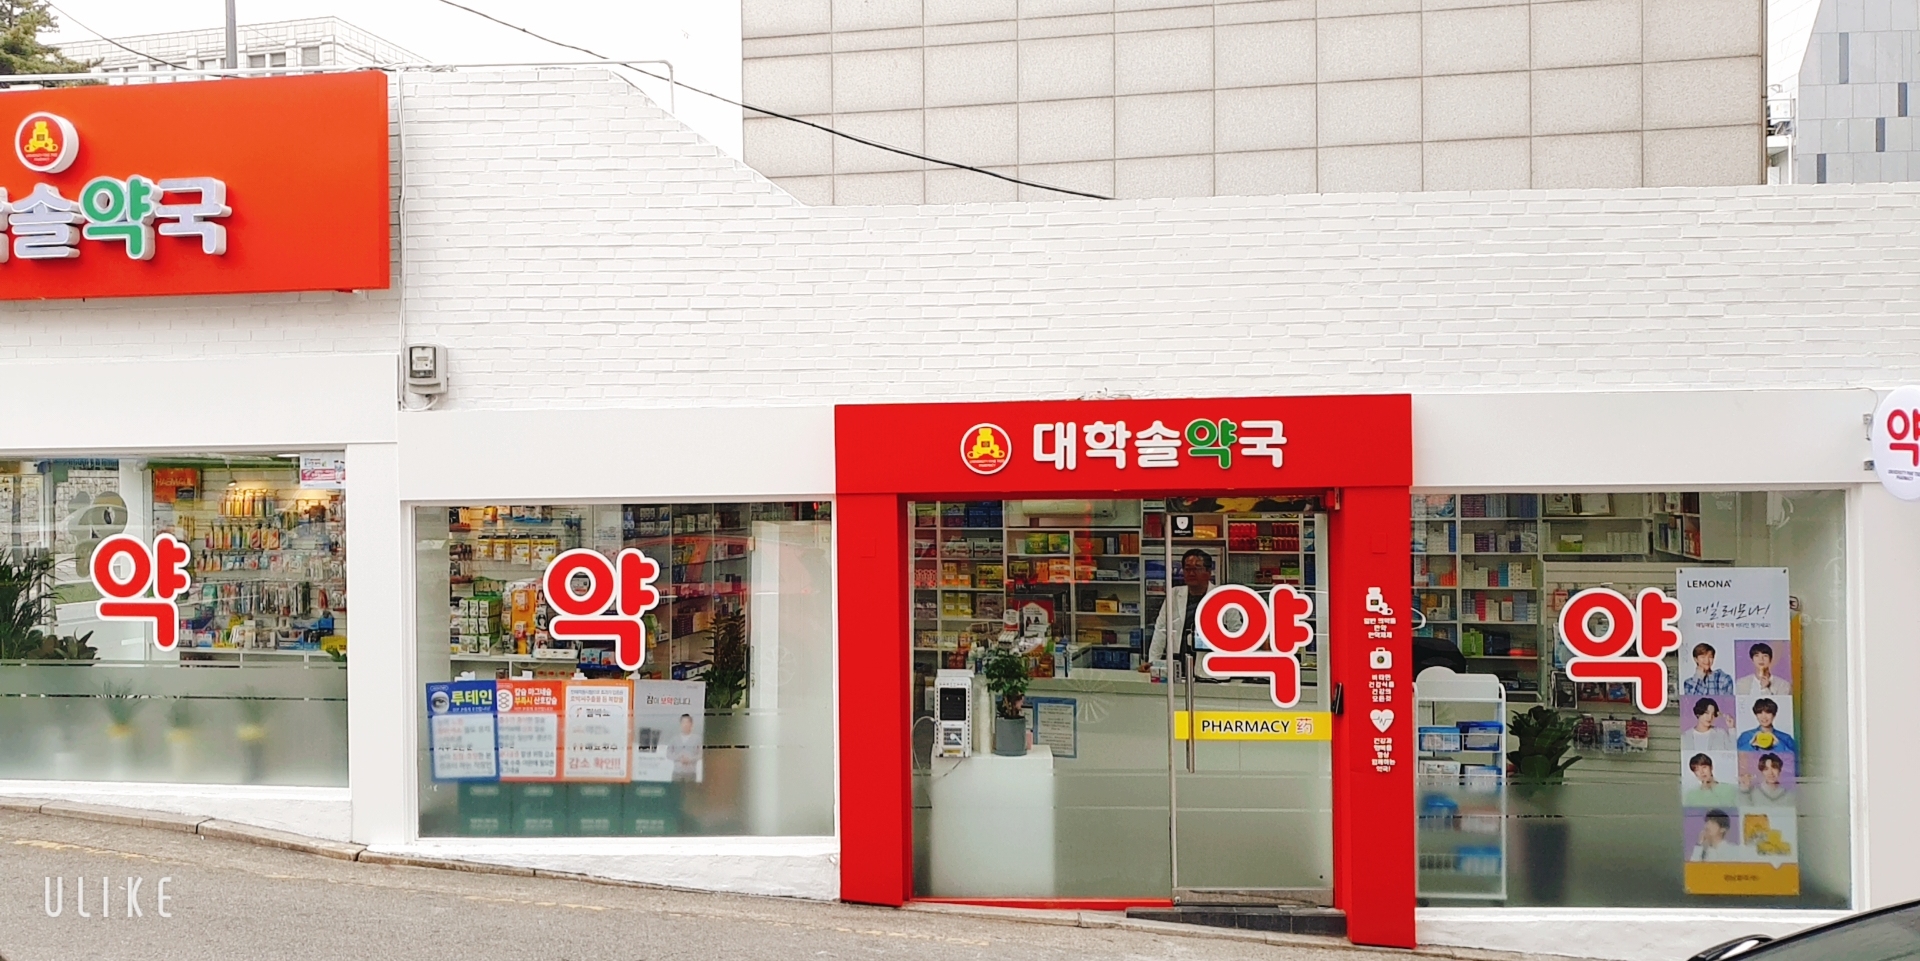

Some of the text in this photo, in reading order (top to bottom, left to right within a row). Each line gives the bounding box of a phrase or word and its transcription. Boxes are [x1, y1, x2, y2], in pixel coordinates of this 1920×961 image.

[0, 174, 232, 263] 솔약국
[1032, 417, 1288, 470] 대학솔약국
[90, 533, 190, 652] 약
[543, 547, 660, 671] 약
[1687, 579, 1731, 589] LEMONA
[1195, 583, 1313, 709] 약
[1559, 586, 1682, 714] 약
[451, 689, 492, 706] 루테인
[514, 687, 552, 696] 칼슘 마그네슘
[646, 695, 660, 705] 잠이
[1201, 719, 1290, 734] PHARMACY
